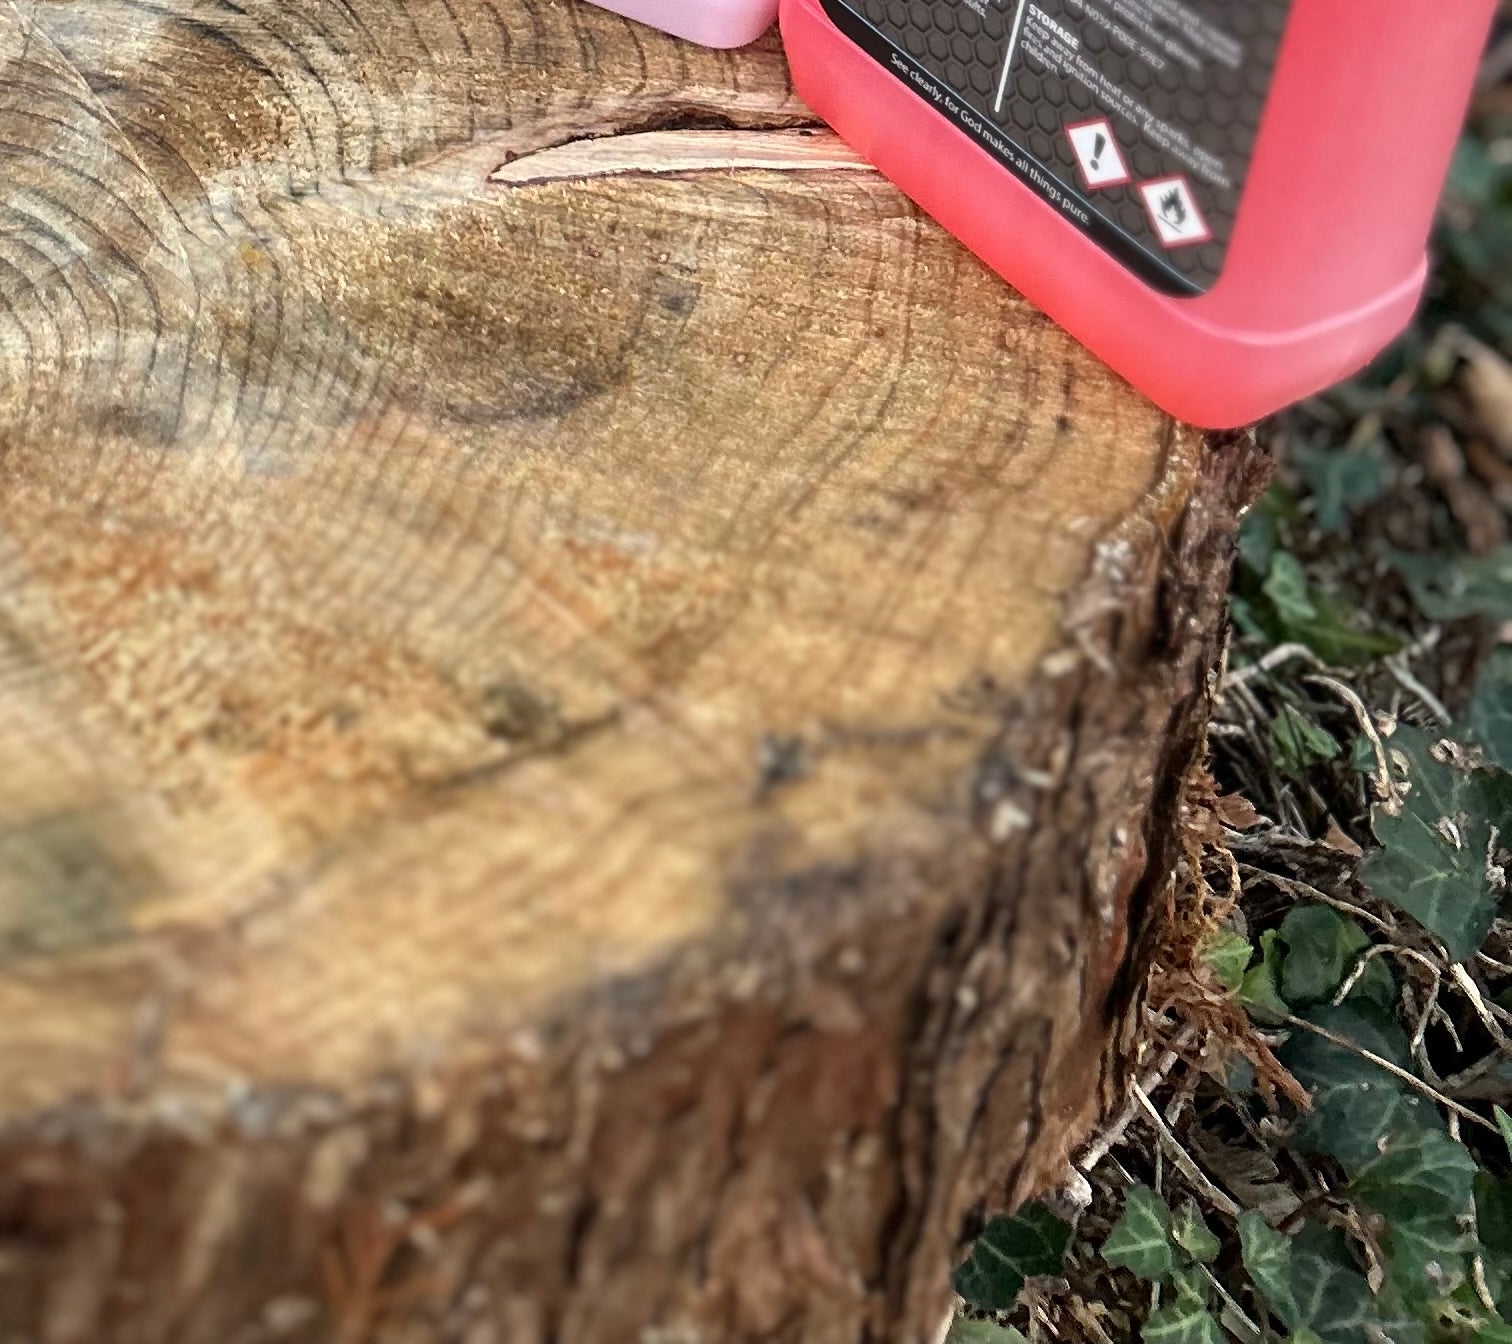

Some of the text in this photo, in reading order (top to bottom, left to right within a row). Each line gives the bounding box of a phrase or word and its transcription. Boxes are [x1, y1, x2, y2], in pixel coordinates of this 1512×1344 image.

[1029, 4, 1079, 49] STORAGE
[891, 53, 908, 74] See
[945, 97, 959, 113] for
[961, 110, 982, 133] God
[983, 130, 1014, 161] makes
[1016, 158, 1028, 172] all
[1030, 168, 1060, 200] things
[1062, 198, 1088, 222] pure.
